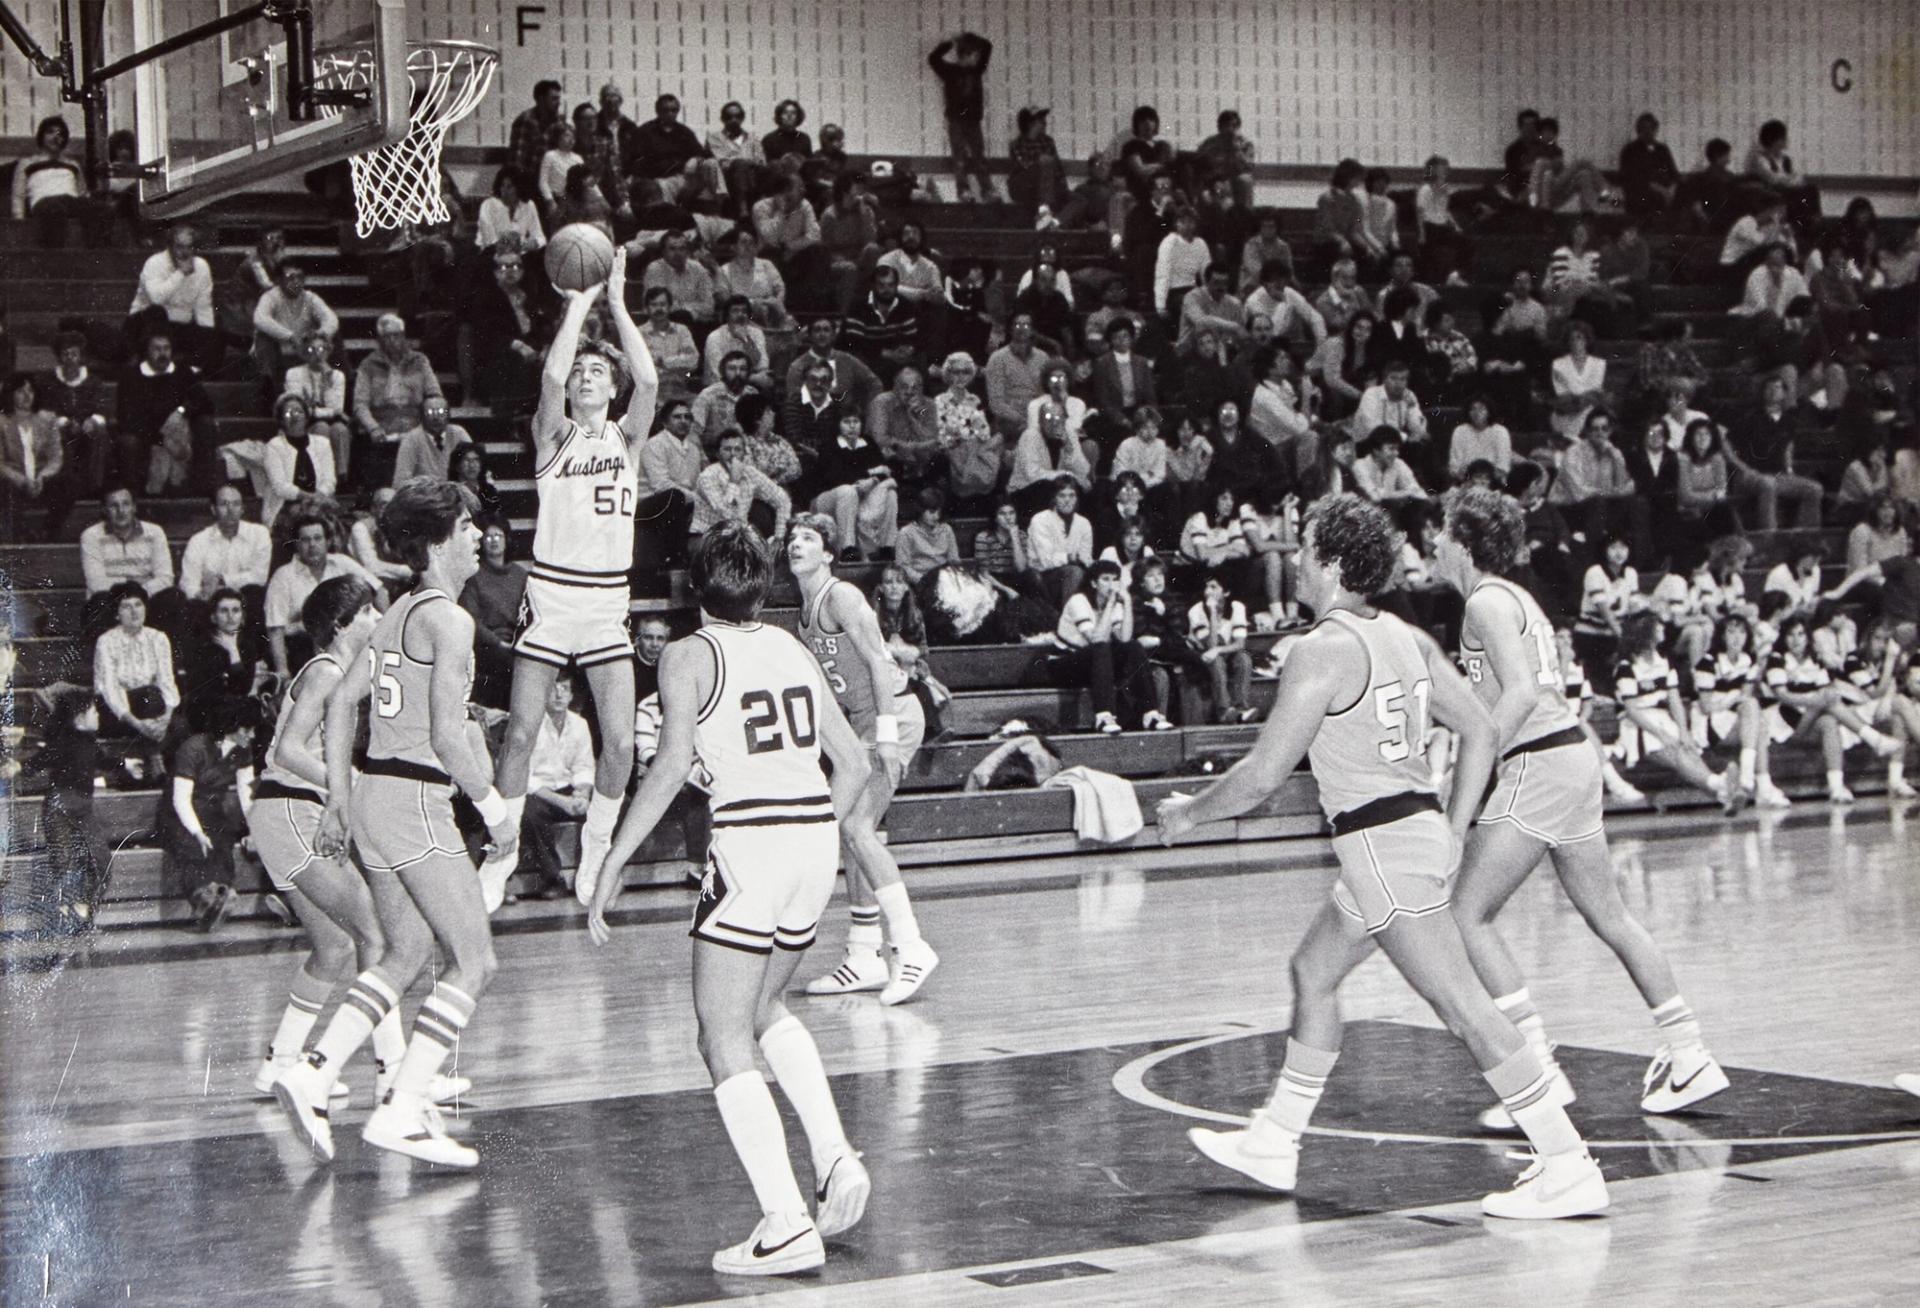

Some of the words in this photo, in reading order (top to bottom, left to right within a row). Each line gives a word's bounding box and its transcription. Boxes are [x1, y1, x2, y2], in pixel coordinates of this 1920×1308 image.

[516, 5, 546, 47] F
[1830, 58, 1852, 94] C
[554, 455, 625, 481] Mustangs
[594, 485, 633, 517] 50
[740, 685, 816, 755] 20
[1373, 678, 1430, 763] 51
